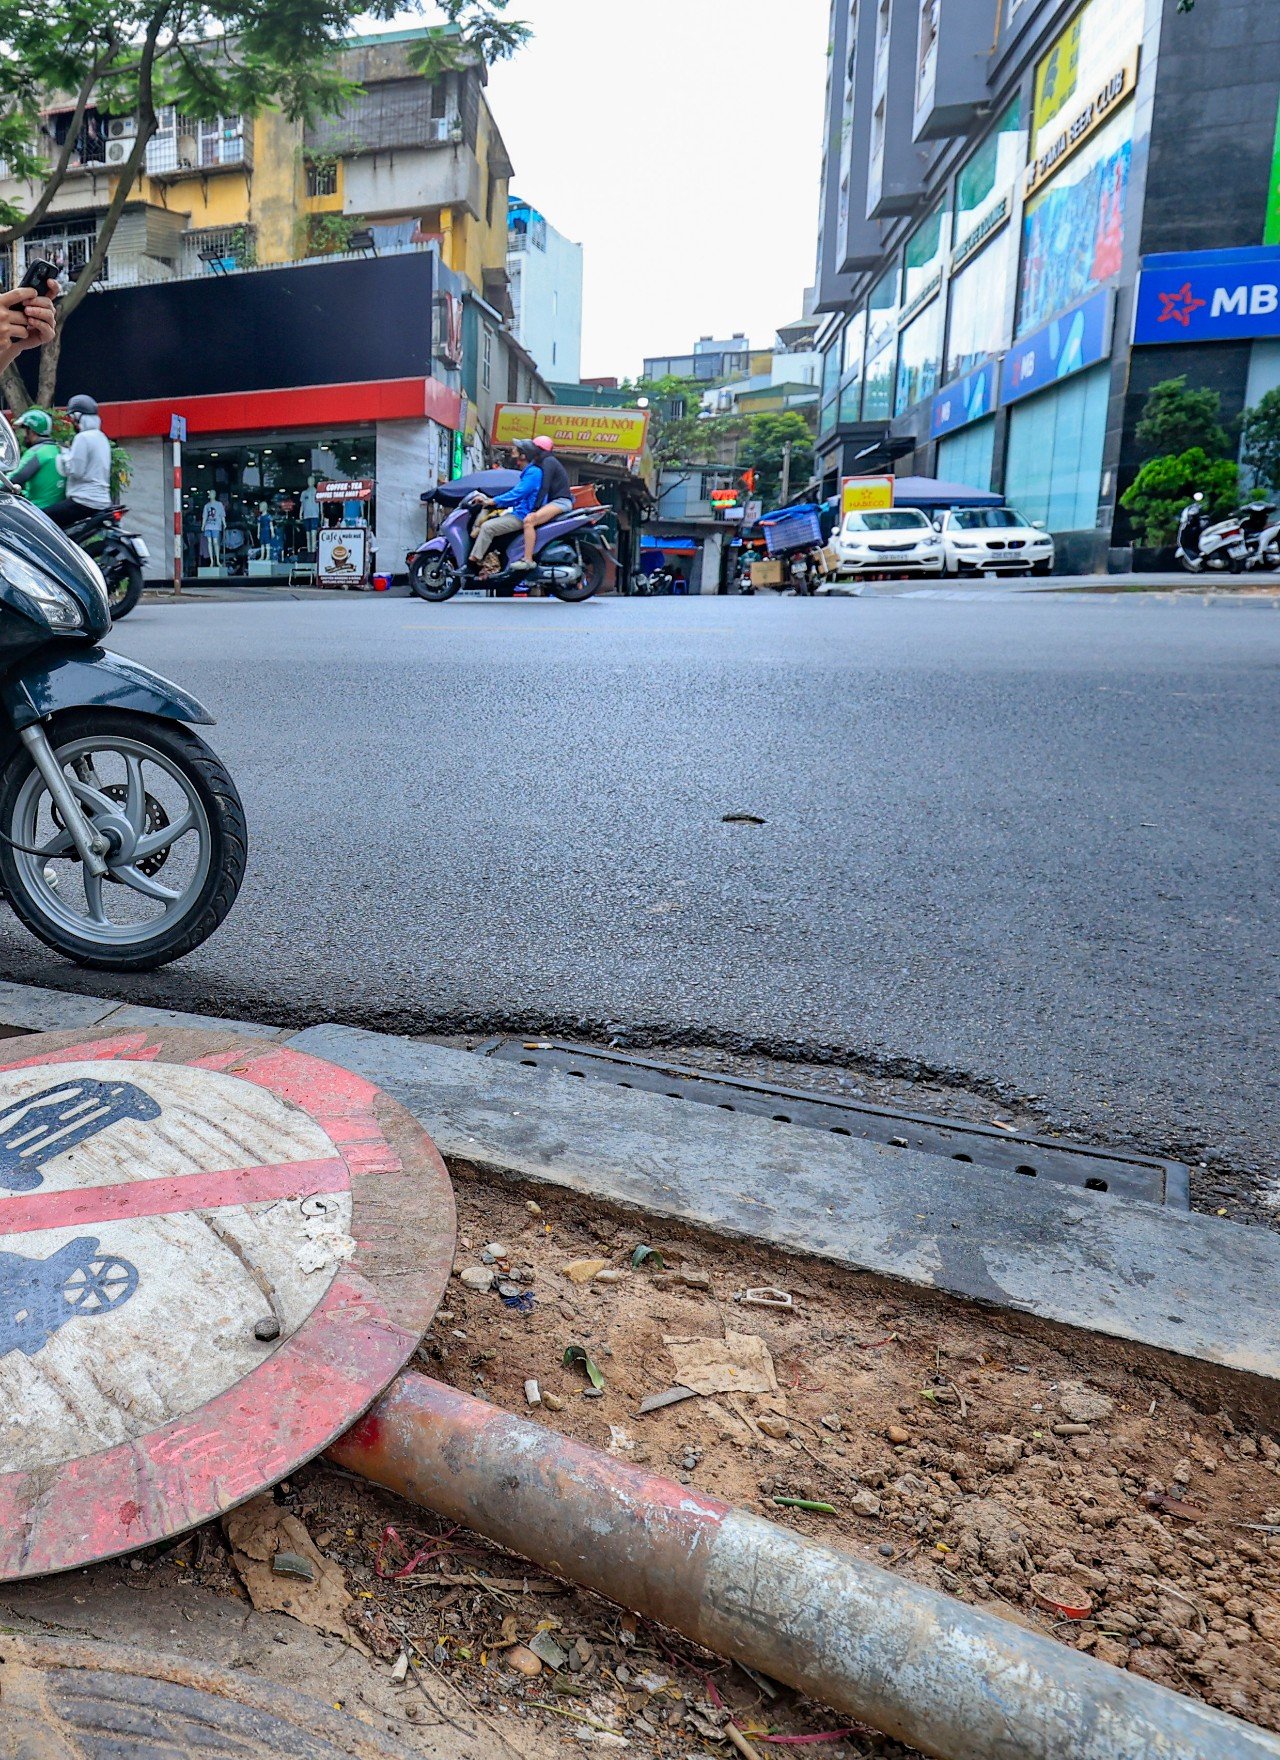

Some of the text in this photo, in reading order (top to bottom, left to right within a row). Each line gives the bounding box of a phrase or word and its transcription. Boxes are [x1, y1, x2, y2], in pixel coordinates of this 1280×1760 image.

[1096, 68, 1125, 114] CLUB
[1210, 284, 1278, 318] MB
[1021, 350, 1035, 379] MB
[544, 414, 563, 426] BIA
[591, 416, 609, 428] HÀ
[554, 430, 573, 440] BIA
[594, 433, 619, 442] ANH
[326, 481, 363, 491] COFFEE TEA
